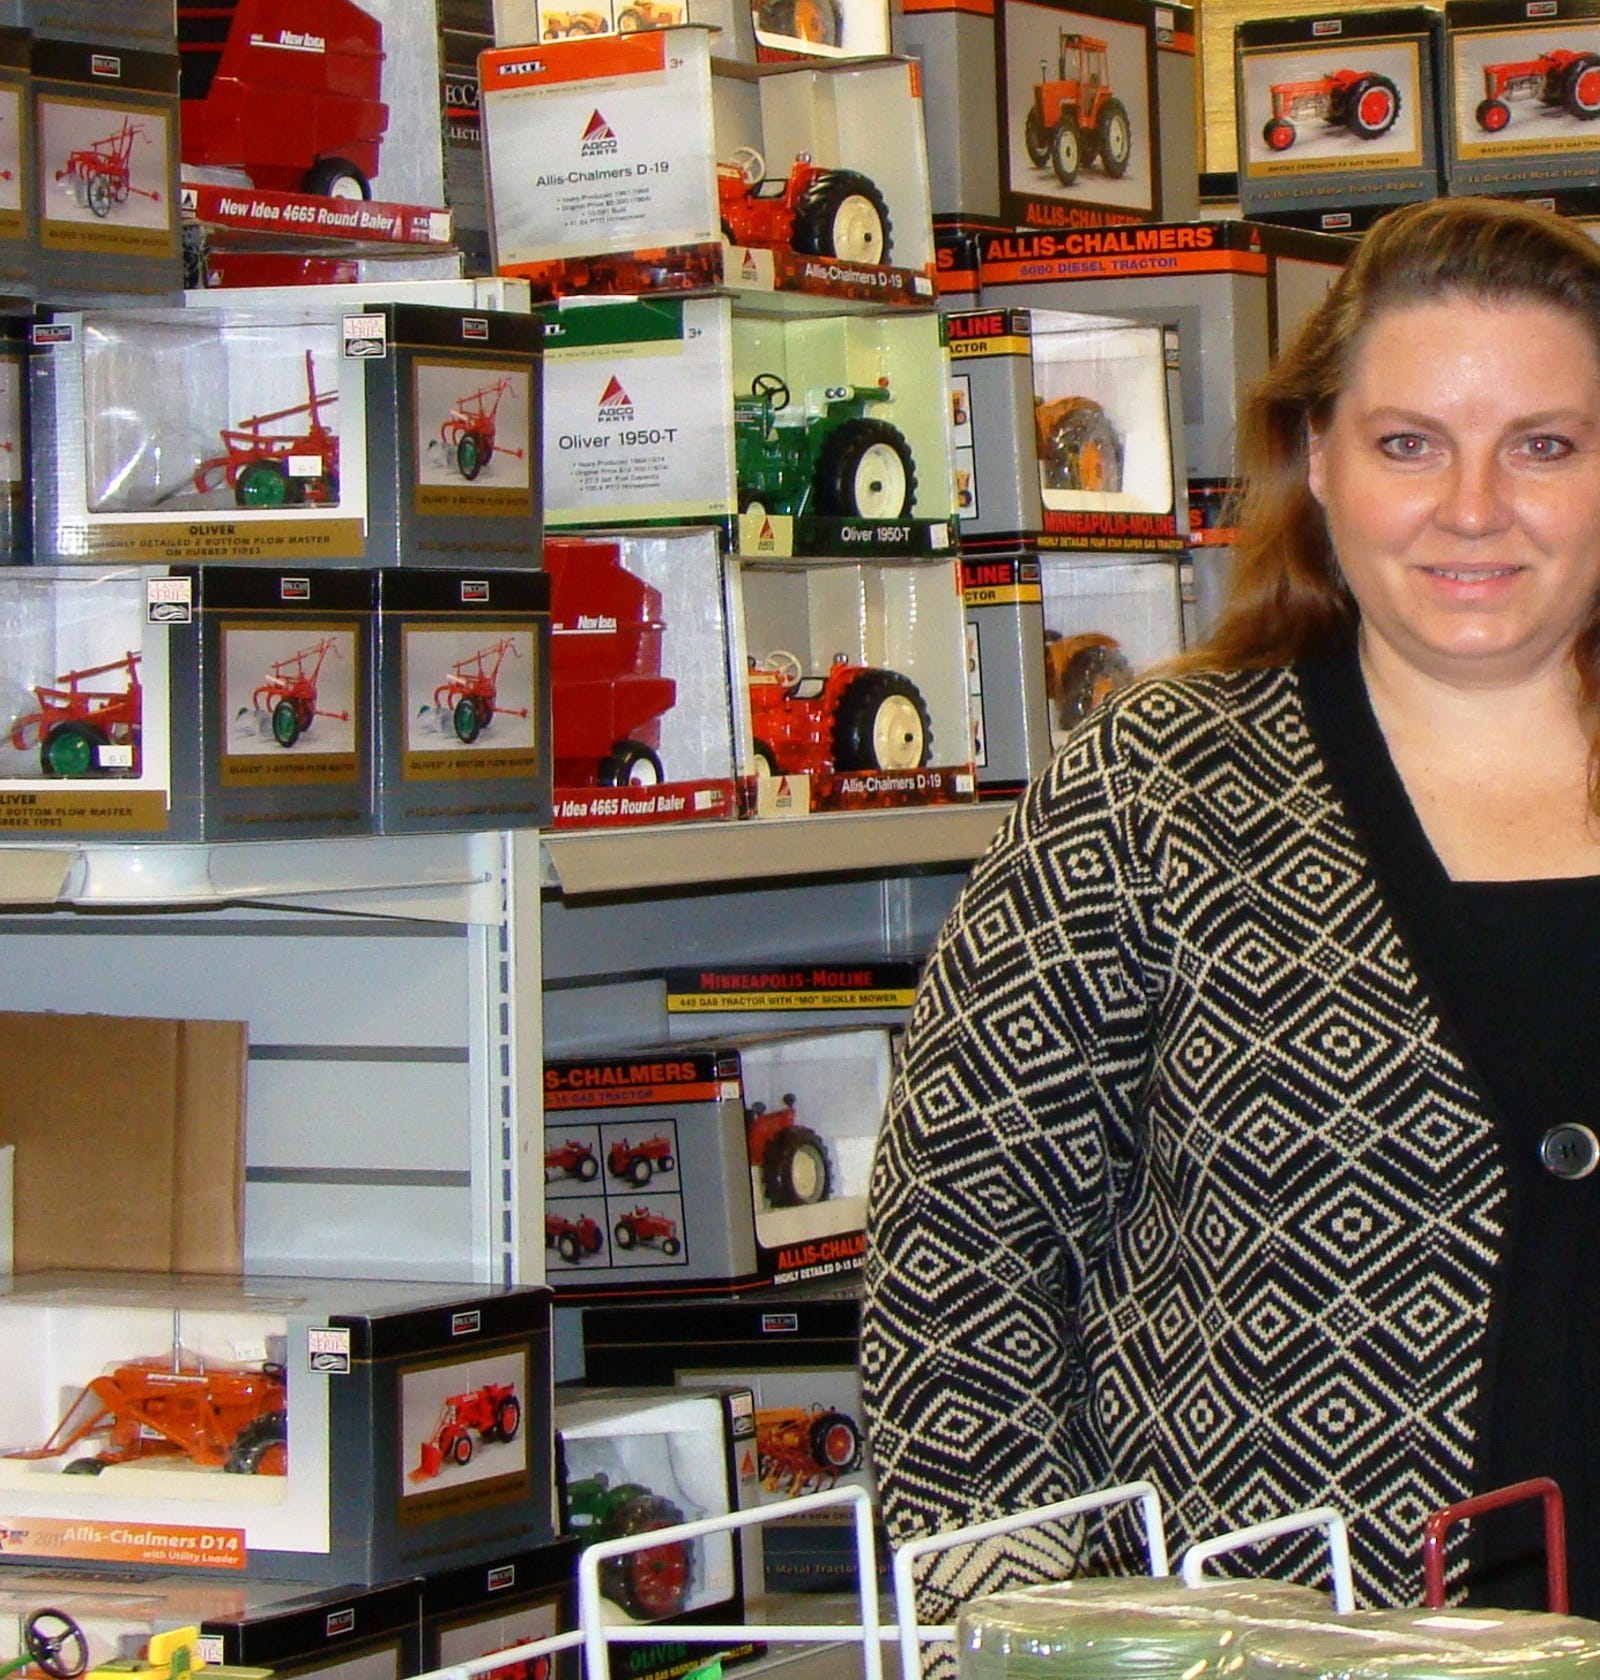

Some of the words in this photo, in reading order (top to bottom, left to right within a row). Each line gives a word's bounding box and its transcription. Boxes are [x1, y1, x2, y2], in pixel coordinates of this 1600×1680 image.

[670, 58, 684, 69] 3+
[536, 167, 633, 188] Allis-Chalmers
[220, 198, 248, 217] New
[251, 202, 280, 219] Idea
[283, 204, 316, 223] 4665
[317, 208, 353, 227] Round
[361, 212, 394, 231] Baler
[986, 227, 1215, 260] ALLIS-CHALMERS
[804, 262, 878, 286] Allis-Chalmers
[1057, 261, 1105, 275] DIESEL
[1111, 257, 1178, 271] TRACTOR
[558, 434, 611, 450] Oliver
[618, 428, 678, 446] 1950-T
[189, 525, 236, 536] OLIVER
[841, 526, 873, 542] Oliver
[877, 526, 911, 542] 1950-T
[1044, 513, 1176, 536] MINNEAPOLIS-MOLINE
[841, 776, 915, 794] Allis-Chalmers
[0, 794, 37, 806] LIVER
[562, 800, 588, 818] Idea
[590, 799, 618, 817] 4665
[620, 797, 656, 815] Round
[657, 795, 685, 812] Baler
[701, 970, 873, 989] MINNEAPOLIS-MOLINE
[721, 996, 766, 1006] TRACTOR
[859, 993, 898, 1003] MOWER
[545, 1062, 698, 1089] S-CHALMERS
[778, 1234, 865, 1271] ALLIS-CHALM
[63, 1526, 196, 1550] Allis-Chalmers
[200, 1534, 239, 1551] D14
[143, 1550, 166, 1560] with
[168, 1550, 200, 1563] Utility
[201, 1554, 239, 1565] Loader
